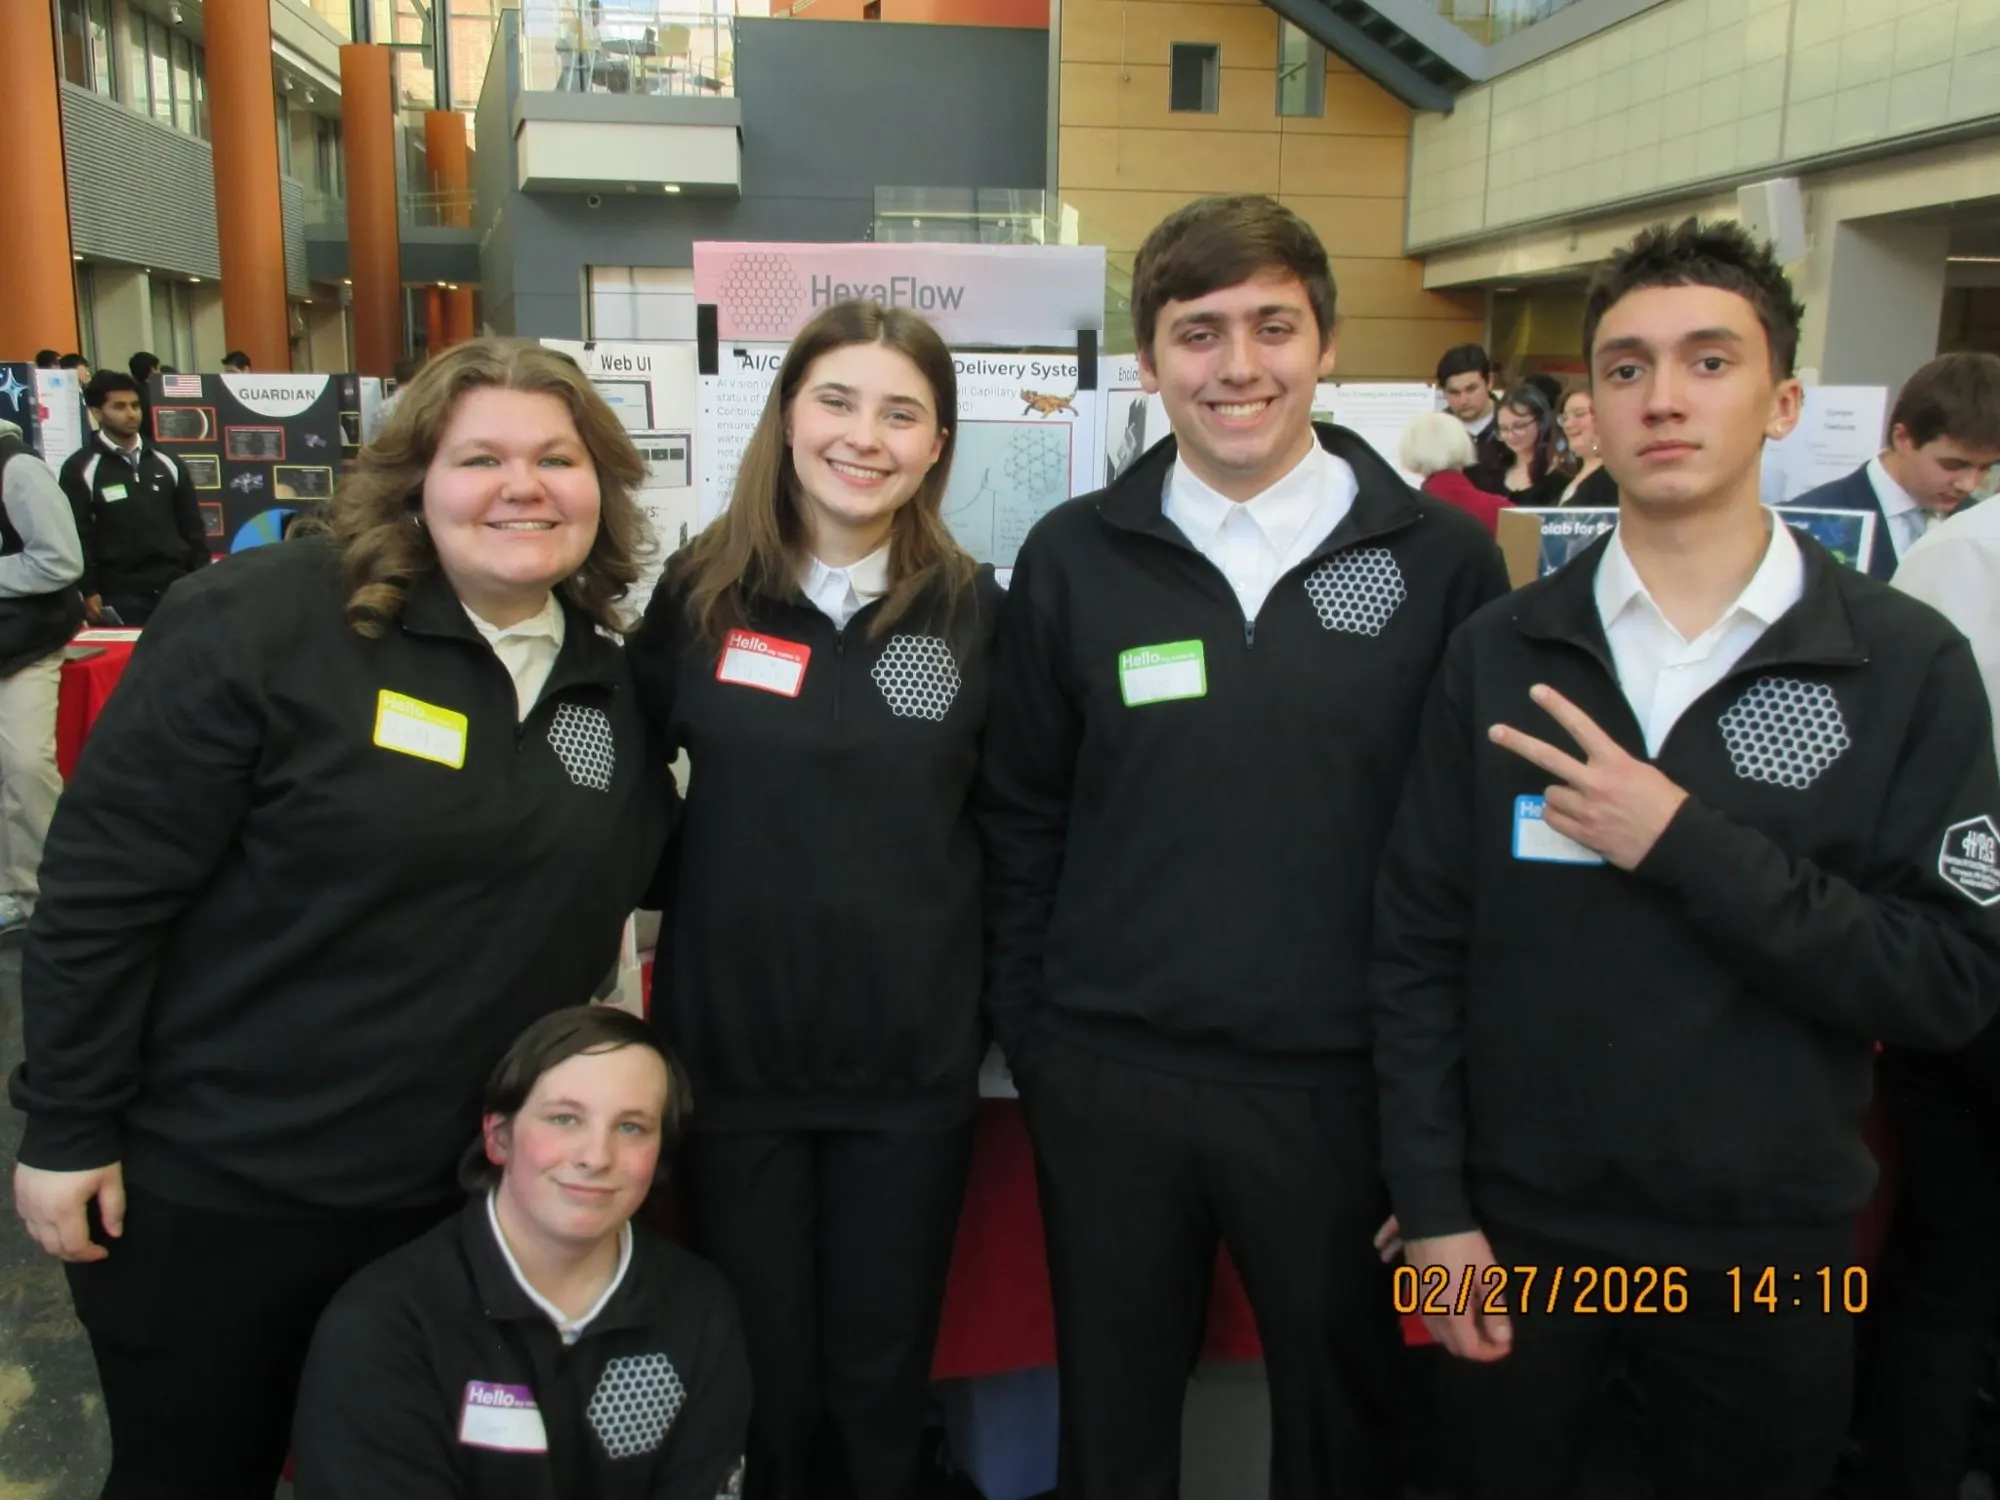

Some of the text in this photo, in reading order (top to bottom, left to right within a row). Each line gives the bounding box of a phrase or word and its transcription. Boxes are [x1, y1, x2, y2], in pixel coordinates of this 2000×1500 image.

[811, 274, 965, 311] HexaFlow
[601, 354, 652, 372] Web UI
[741, 354, 782, 372] AI/C
[954, 359, 1078, 381] Delivery Syste
[1118, 365, 1139, 383] Enclo
[717, 379, 727, 388] AI
[730, 379, 760, 388] Vision
[970, 385, 1018, 398] Capillary
[239, 388, 316, 401] GUARDIAN
[717, 394, 747, 403] status
[717, 436, 744, 445] water
[1574, 521, 1596, 536] for
[729, 633, 768, 652] Hello
[1122, 650, 1160, 669] Hello
[383, 694, 426, 718] Hello
[469, 1385, 515, 1407] Hello
